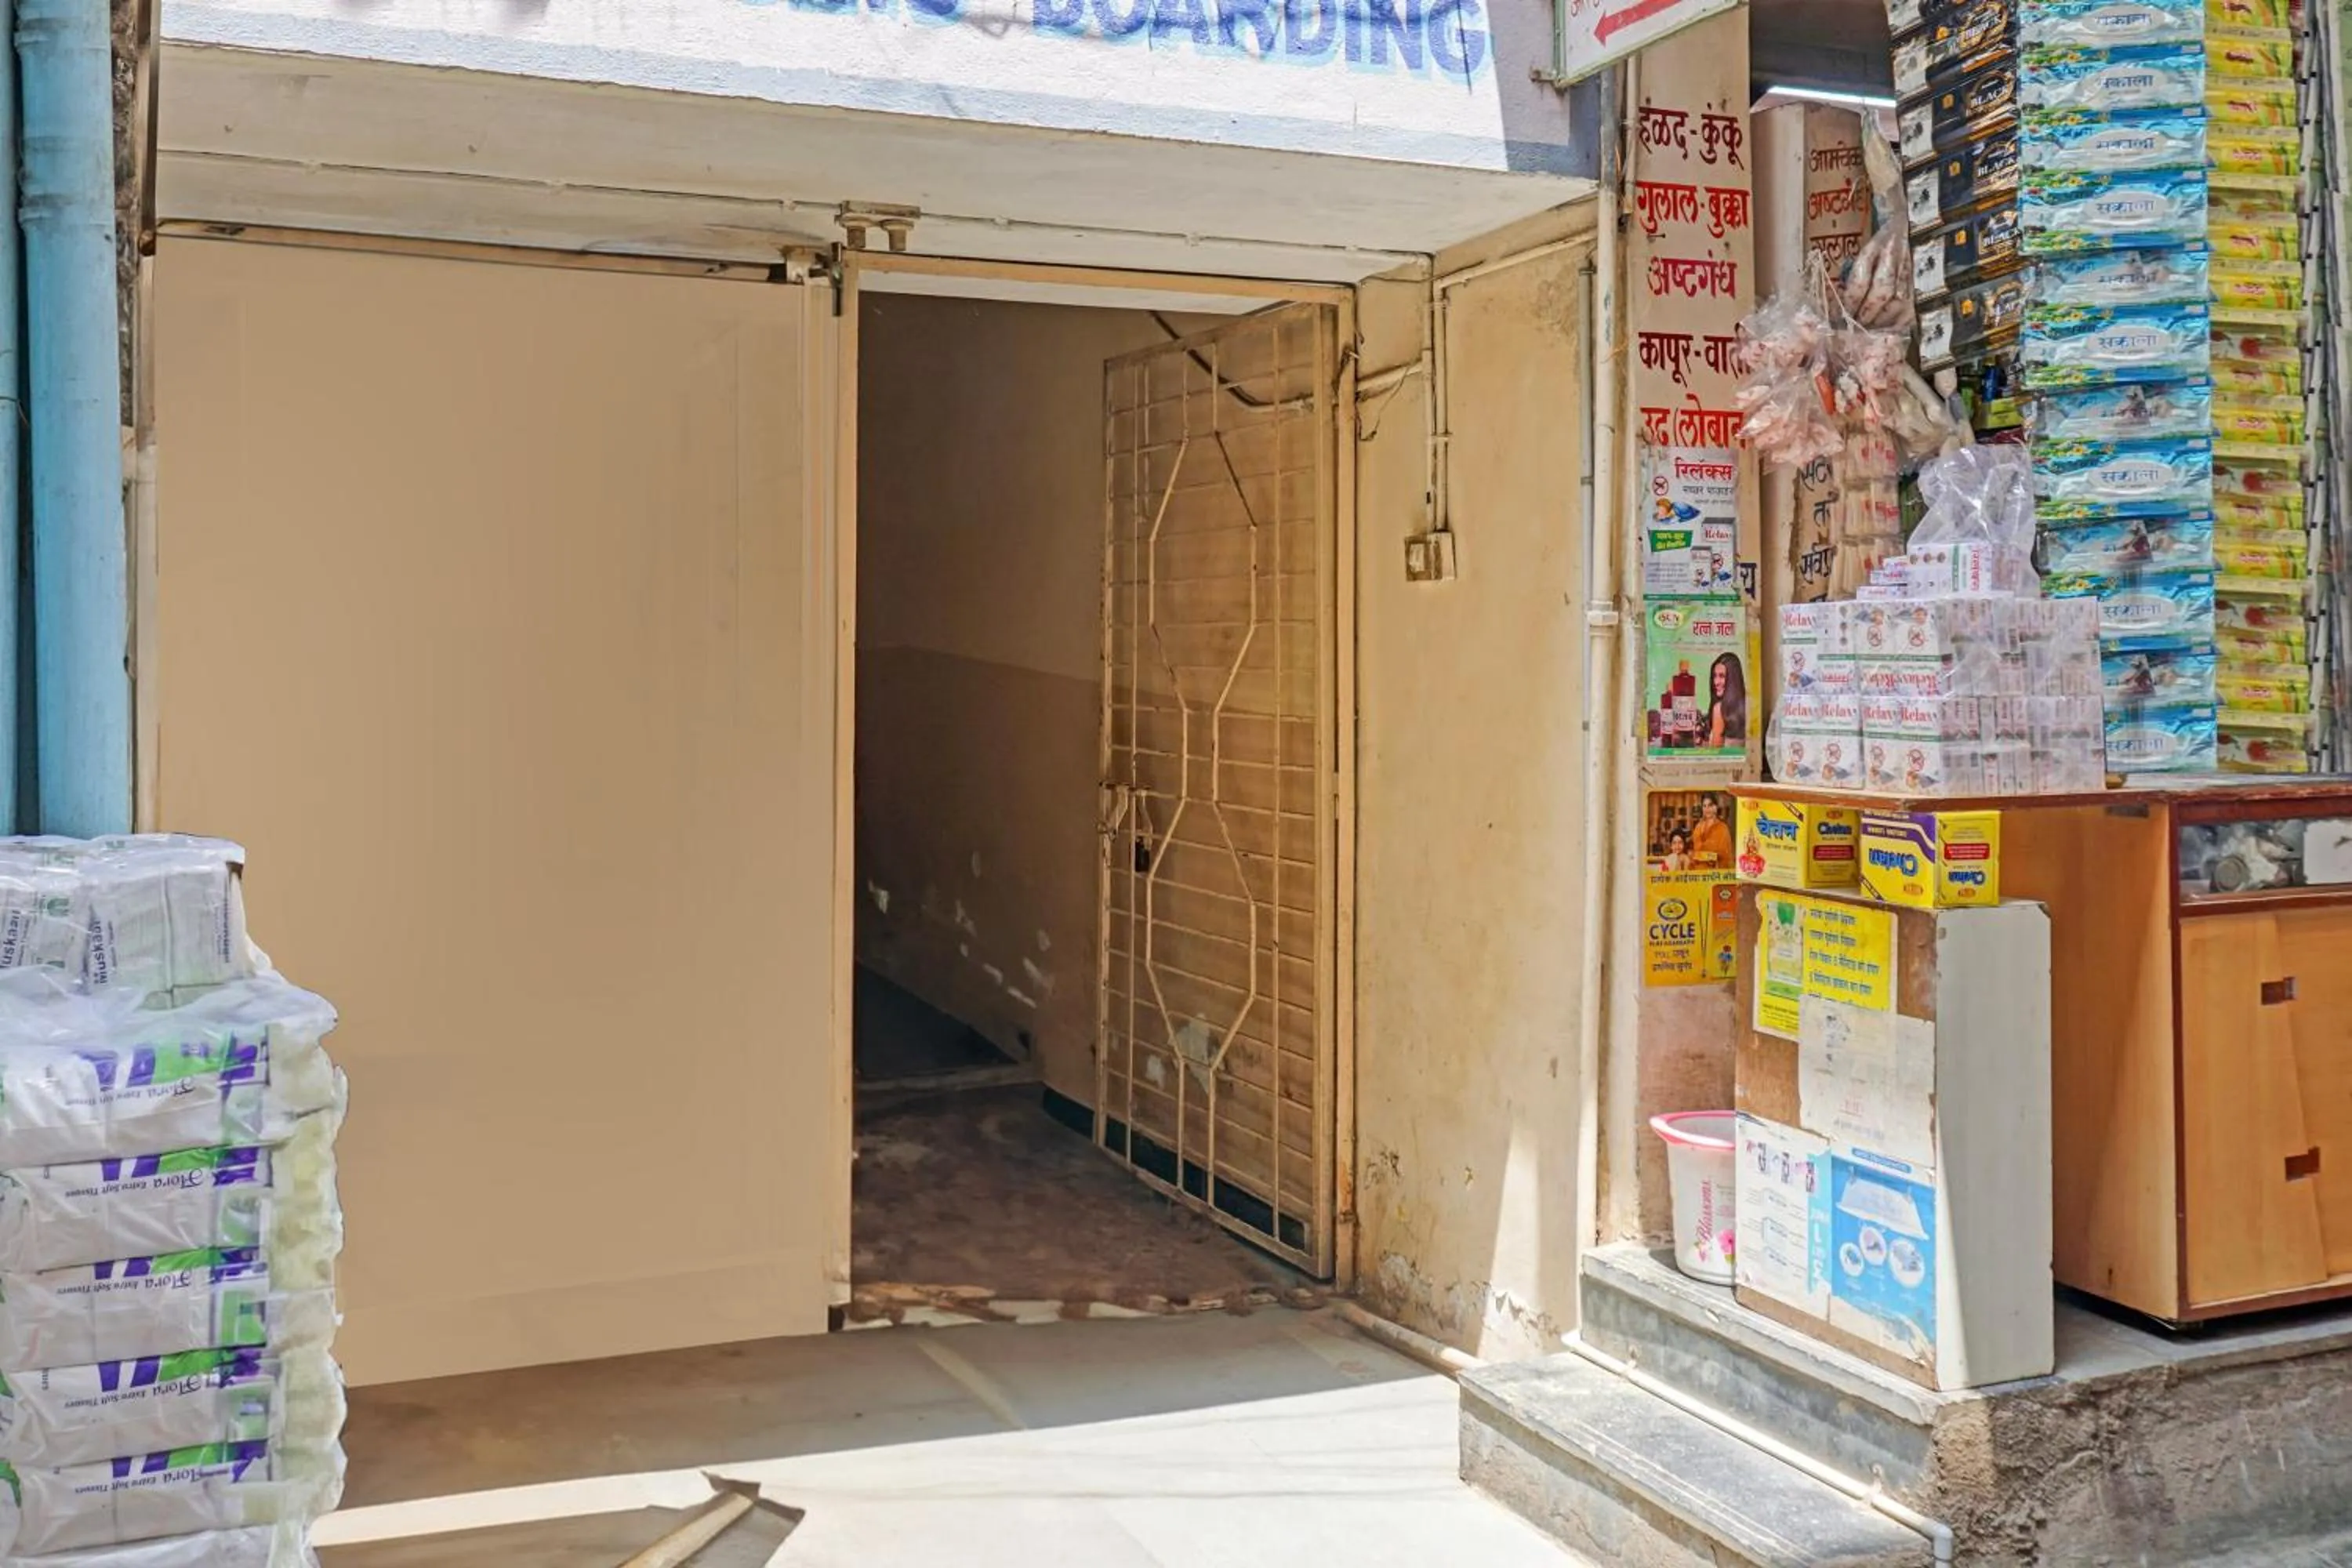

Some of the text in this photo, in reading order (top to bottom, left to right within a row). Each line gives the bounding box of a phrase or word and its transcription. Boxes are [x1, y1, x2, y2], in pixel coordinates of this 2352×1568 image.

[1649, 923, 1696, 940] CYCLE
[143, 1269, 192, 1290] Flora
[151, 1374, 201, 1396] Flora
